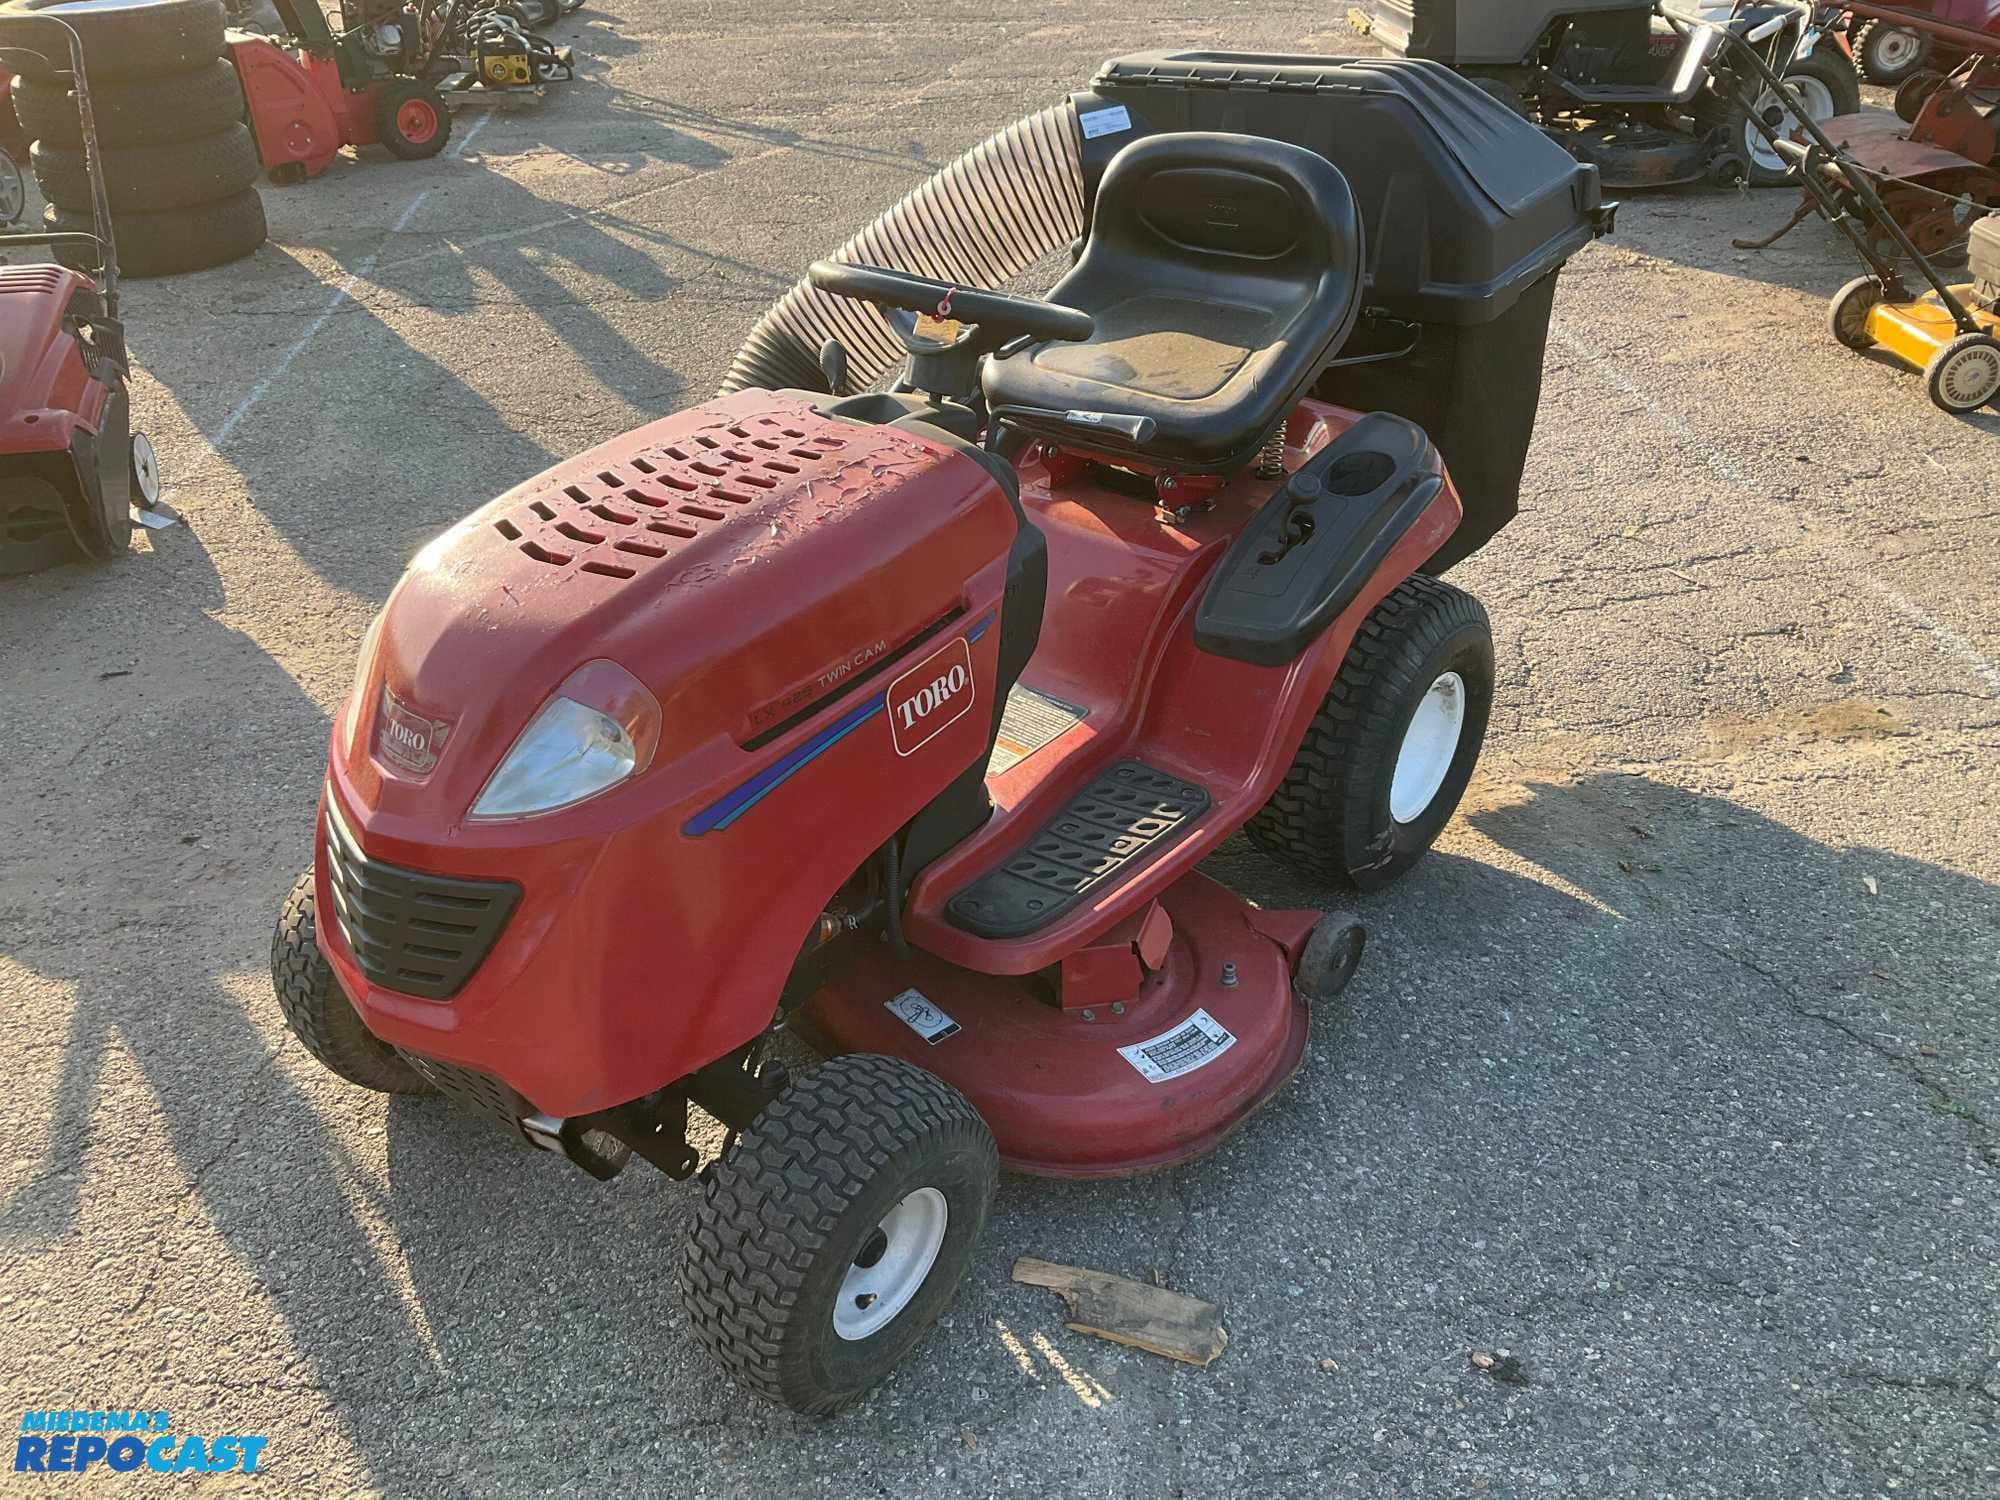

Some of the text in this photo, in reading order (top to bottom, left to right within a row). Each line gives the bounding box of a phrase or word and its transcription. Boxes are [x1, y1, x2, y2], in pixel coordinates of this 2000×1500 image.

[817, 660, 852, 688] TWIN
[853, 639, 887, 666] CAM
[896, 664, 966, 731] TORO
[389, 718, 425, 751] TORO
